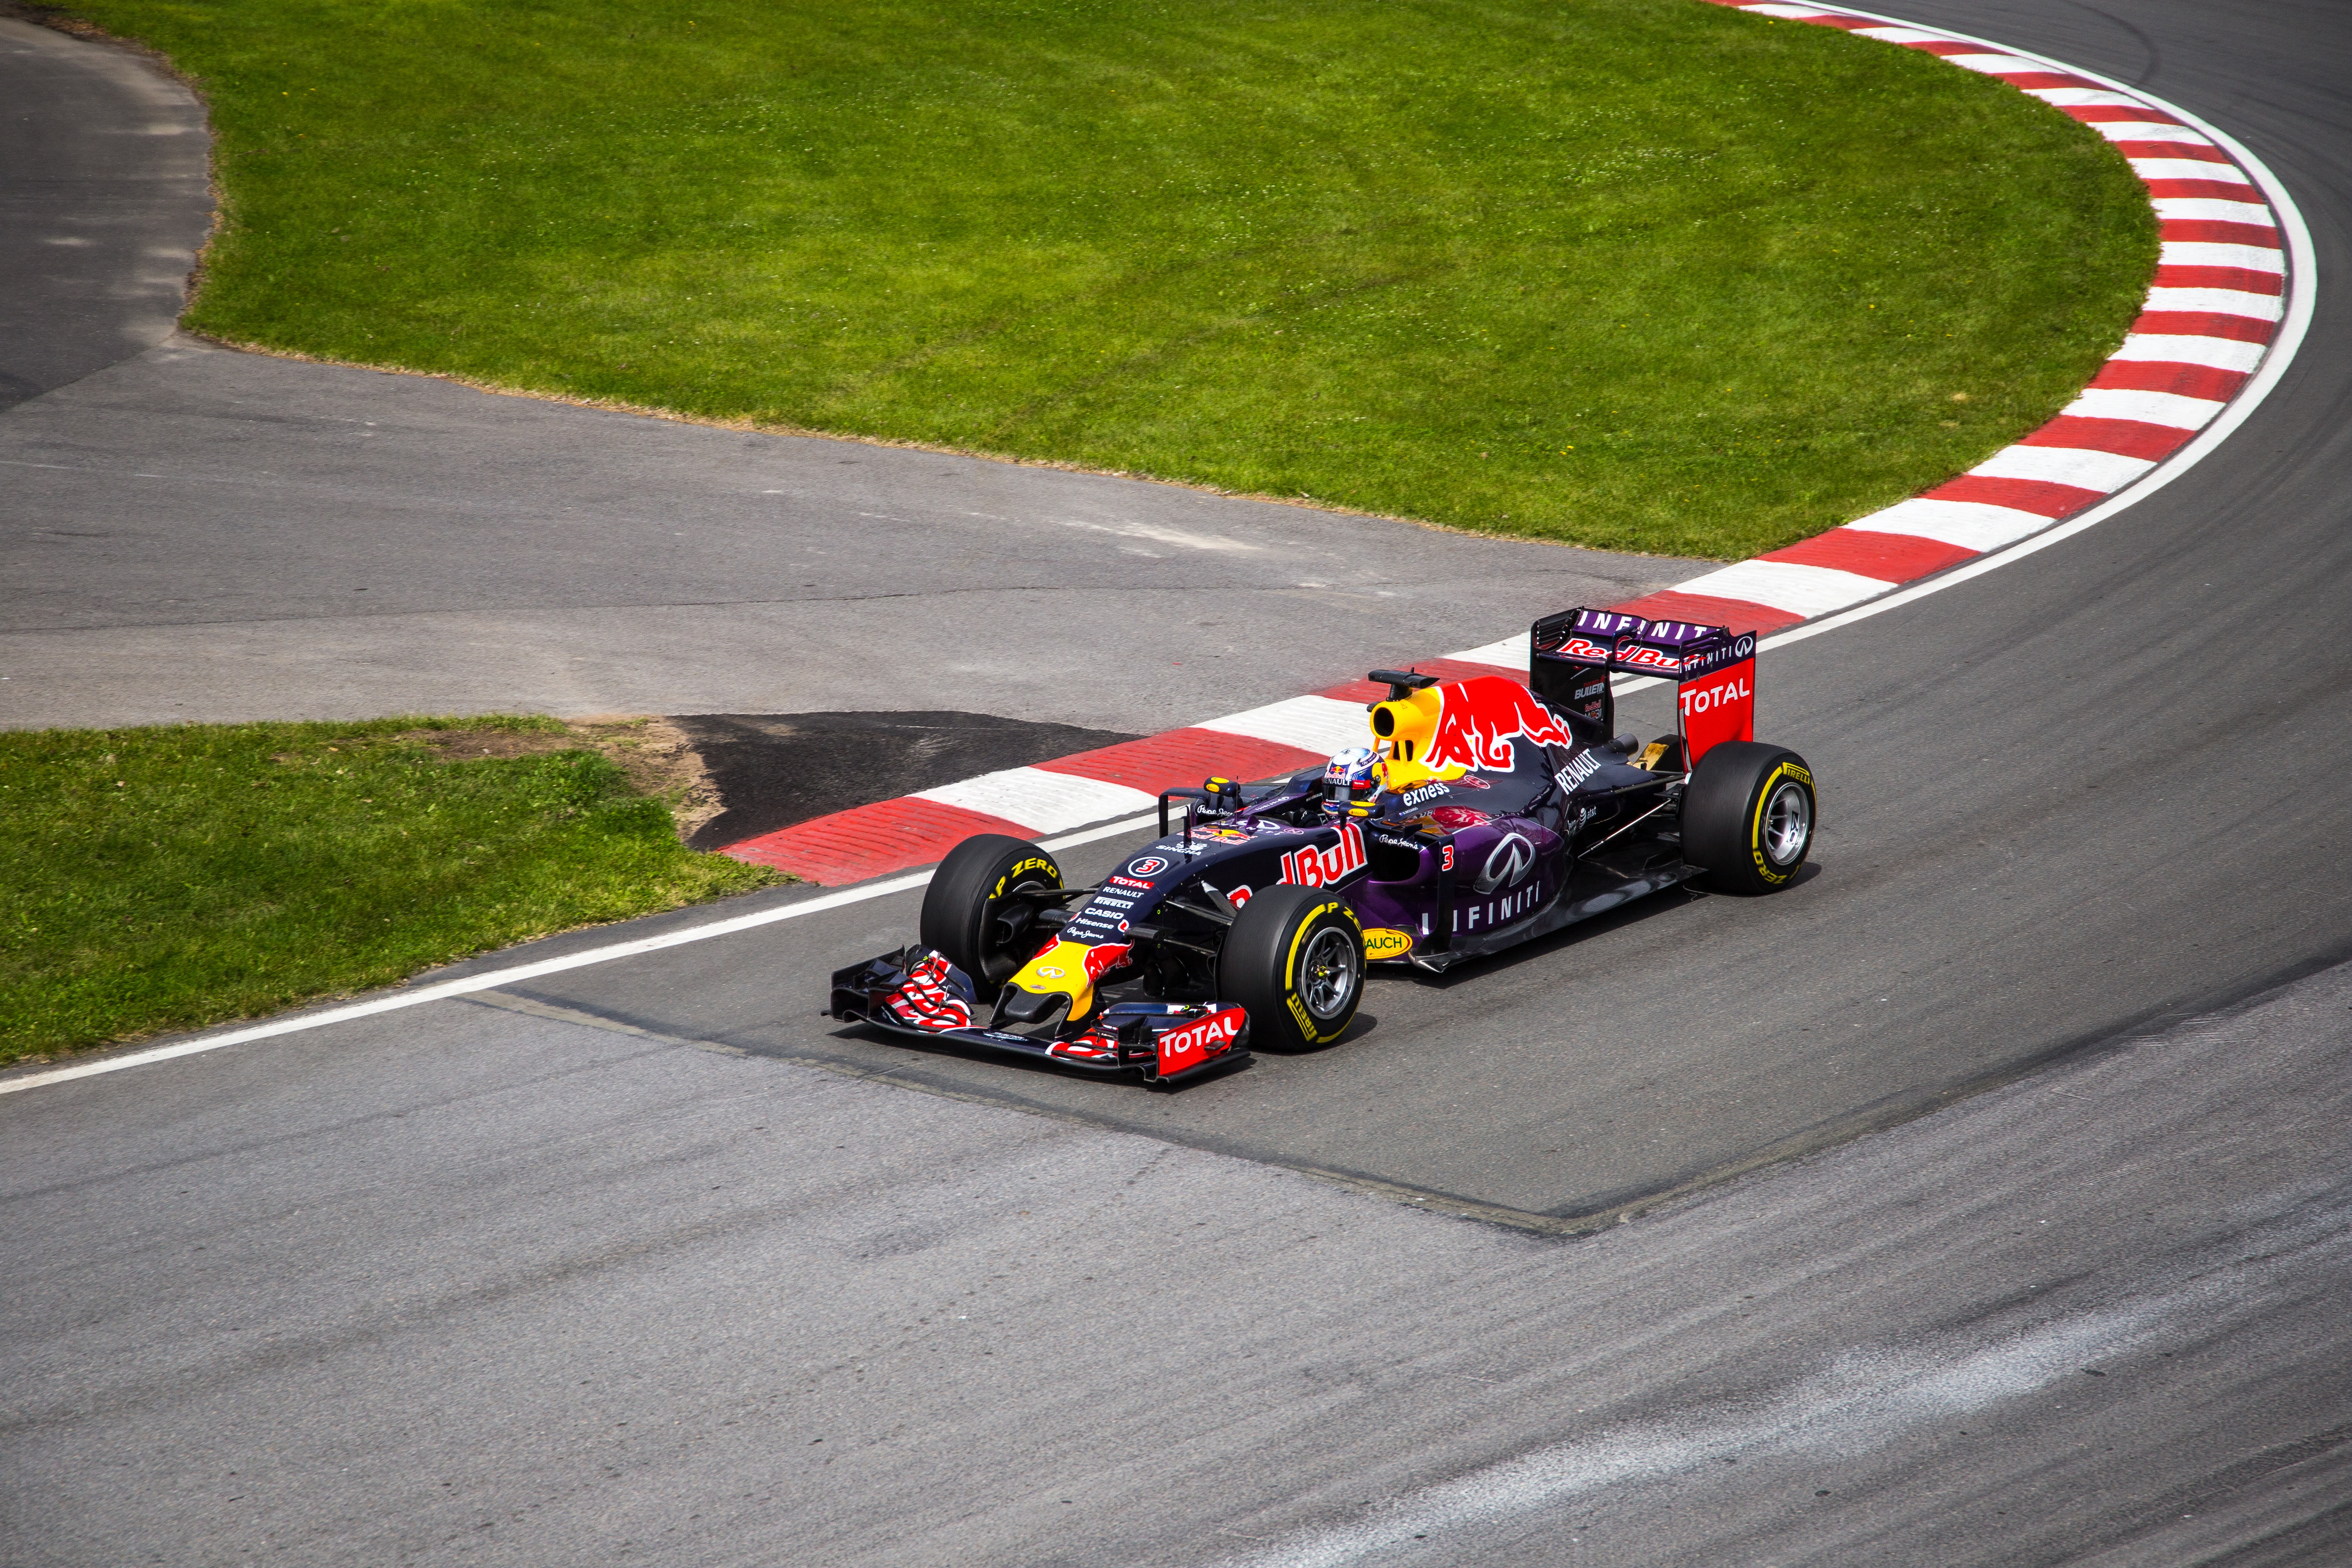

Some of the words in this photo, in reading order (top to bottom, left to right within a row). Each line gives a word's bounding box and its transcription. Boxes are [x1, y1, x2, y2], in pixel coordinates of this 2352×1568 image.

[1577, 611, 1720, 640] INFINIT
[1625, 648, 1679, 669] Bu
[1680, 678, 1750, 717] TOTAL
[1554, 748, 1602, 795] RENAULT
[1782, 762, 1810, 785] PIRELLI
[1323, 778, 1352, 786] RENAULT
[1403, 782, 1450, 806] exness
[1587, 805, 1597, 819] at&t
[1209, 835, 1248, 845] Bull
[1379, 834, 1398, 845] Pepe
[1155, 845, 1202, 856] SINGHA
[1294, 822, 1368, 889] Bull
[1442, 845, 1454, 871] 3
[1135, 859, 1161, 873] 3
[995, 876, 1006, 897] P
[1011, 857, 1058, 879] ZERO
[1113, 876, 1150, 889] TOTAL
[1102, 886, 1144, 898] RENAULT
[1093, 896, 1134, 909] PIRELLI
[1327, 902, 1338, 913] P
[1084, 907, 1124, 919] CASIO
[1075, 918, 1114, 929] Hisense
[1067, 927, 1084, 936] Pepe
[1081, 930, 1104, 939] Jeans
[1286, 992, 1318, 1042] PIRELLI
[1160, 1017, 1239, 1057] TOTAL
